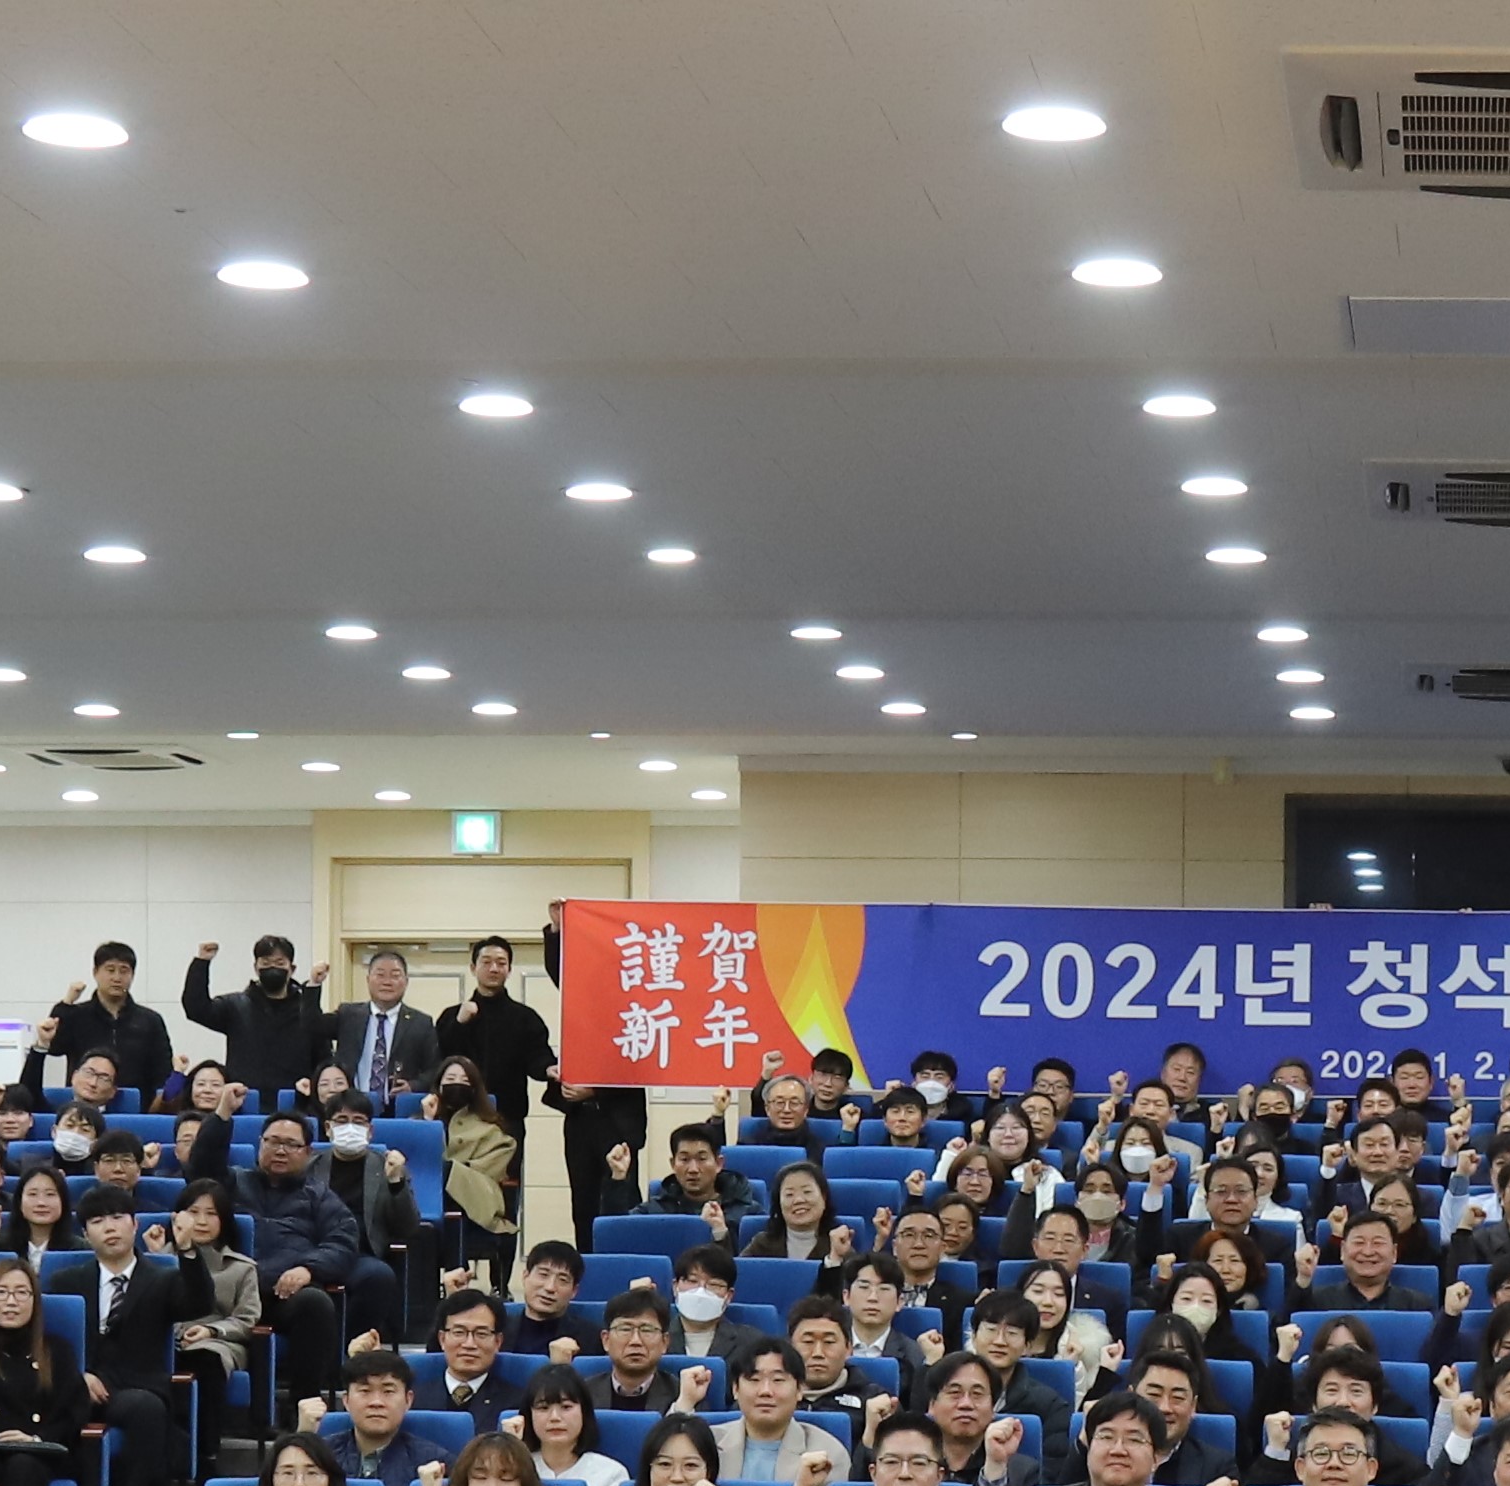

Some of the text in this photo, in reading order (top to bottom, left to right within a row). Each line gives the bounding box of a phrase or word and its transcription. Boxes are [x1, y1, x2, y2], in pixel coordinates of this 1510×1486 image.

[613, 921, 757, 994] 謹賀
[976, 939, 1312, 1027] 2024년
[612, 998, 760, 1069] 新年
[1320, 1050, 1394, 1079] 202
